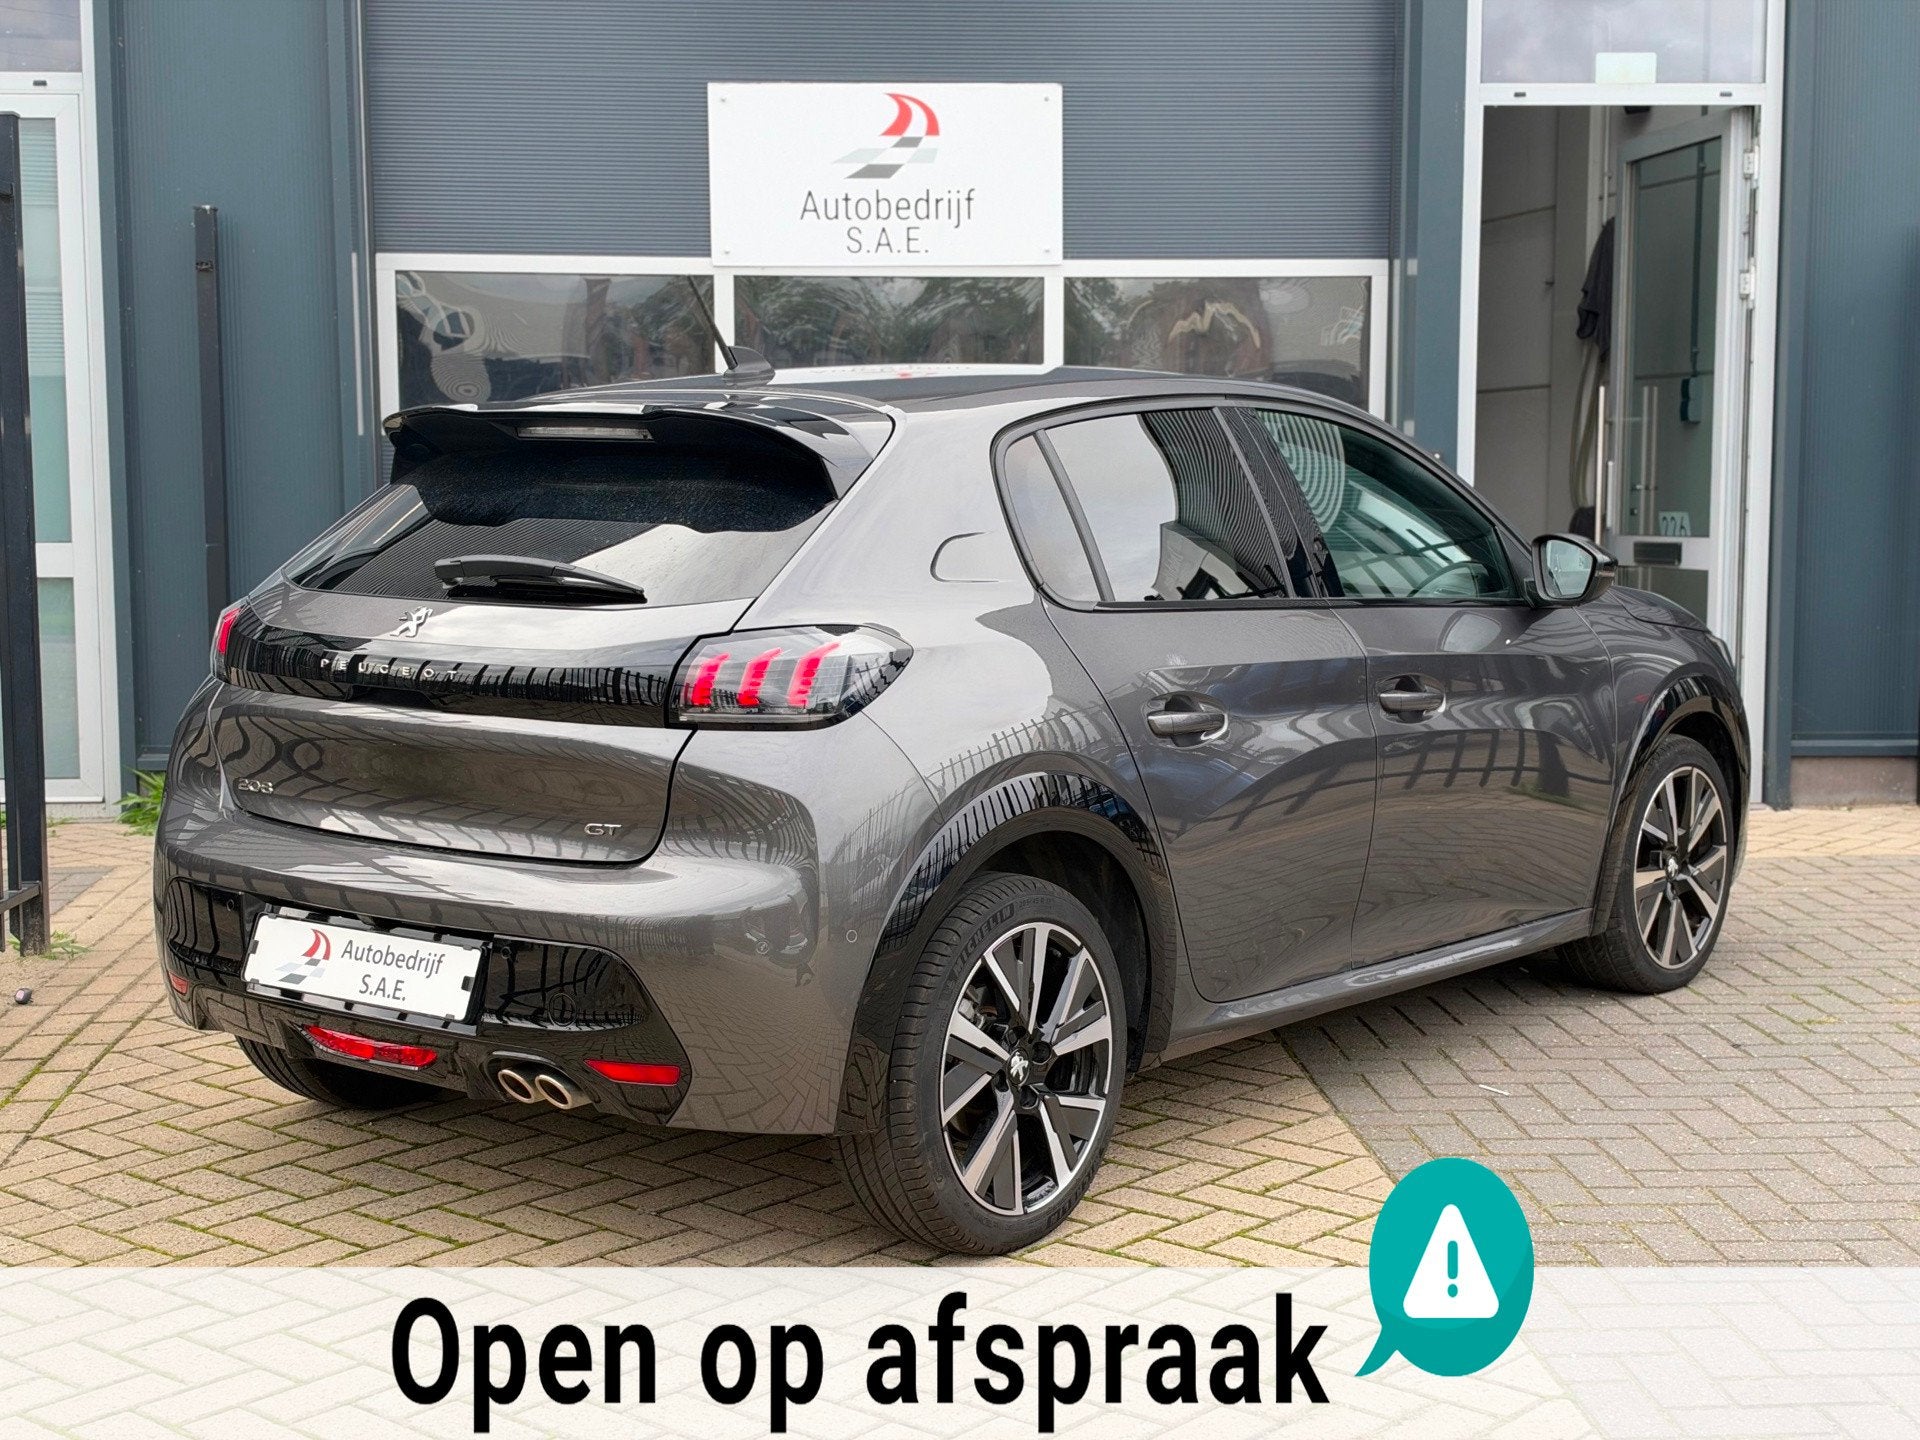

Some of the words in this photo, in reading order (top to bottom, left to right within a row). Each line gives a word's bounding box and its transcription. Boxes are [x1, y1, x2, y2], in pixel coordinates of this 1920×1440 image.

[800, 188, 976, 228] Autobedrijf
[846, 227, 930, 253] S.A.E.
[320, 657, 459, 679] PEUGEOT
[237, 778, 274, 795] 208
[584, 823, 622, 837] GT
[340, 939, 446, 979] Autobedrijf
[358, 973, 407, 1002] S.A.E.
